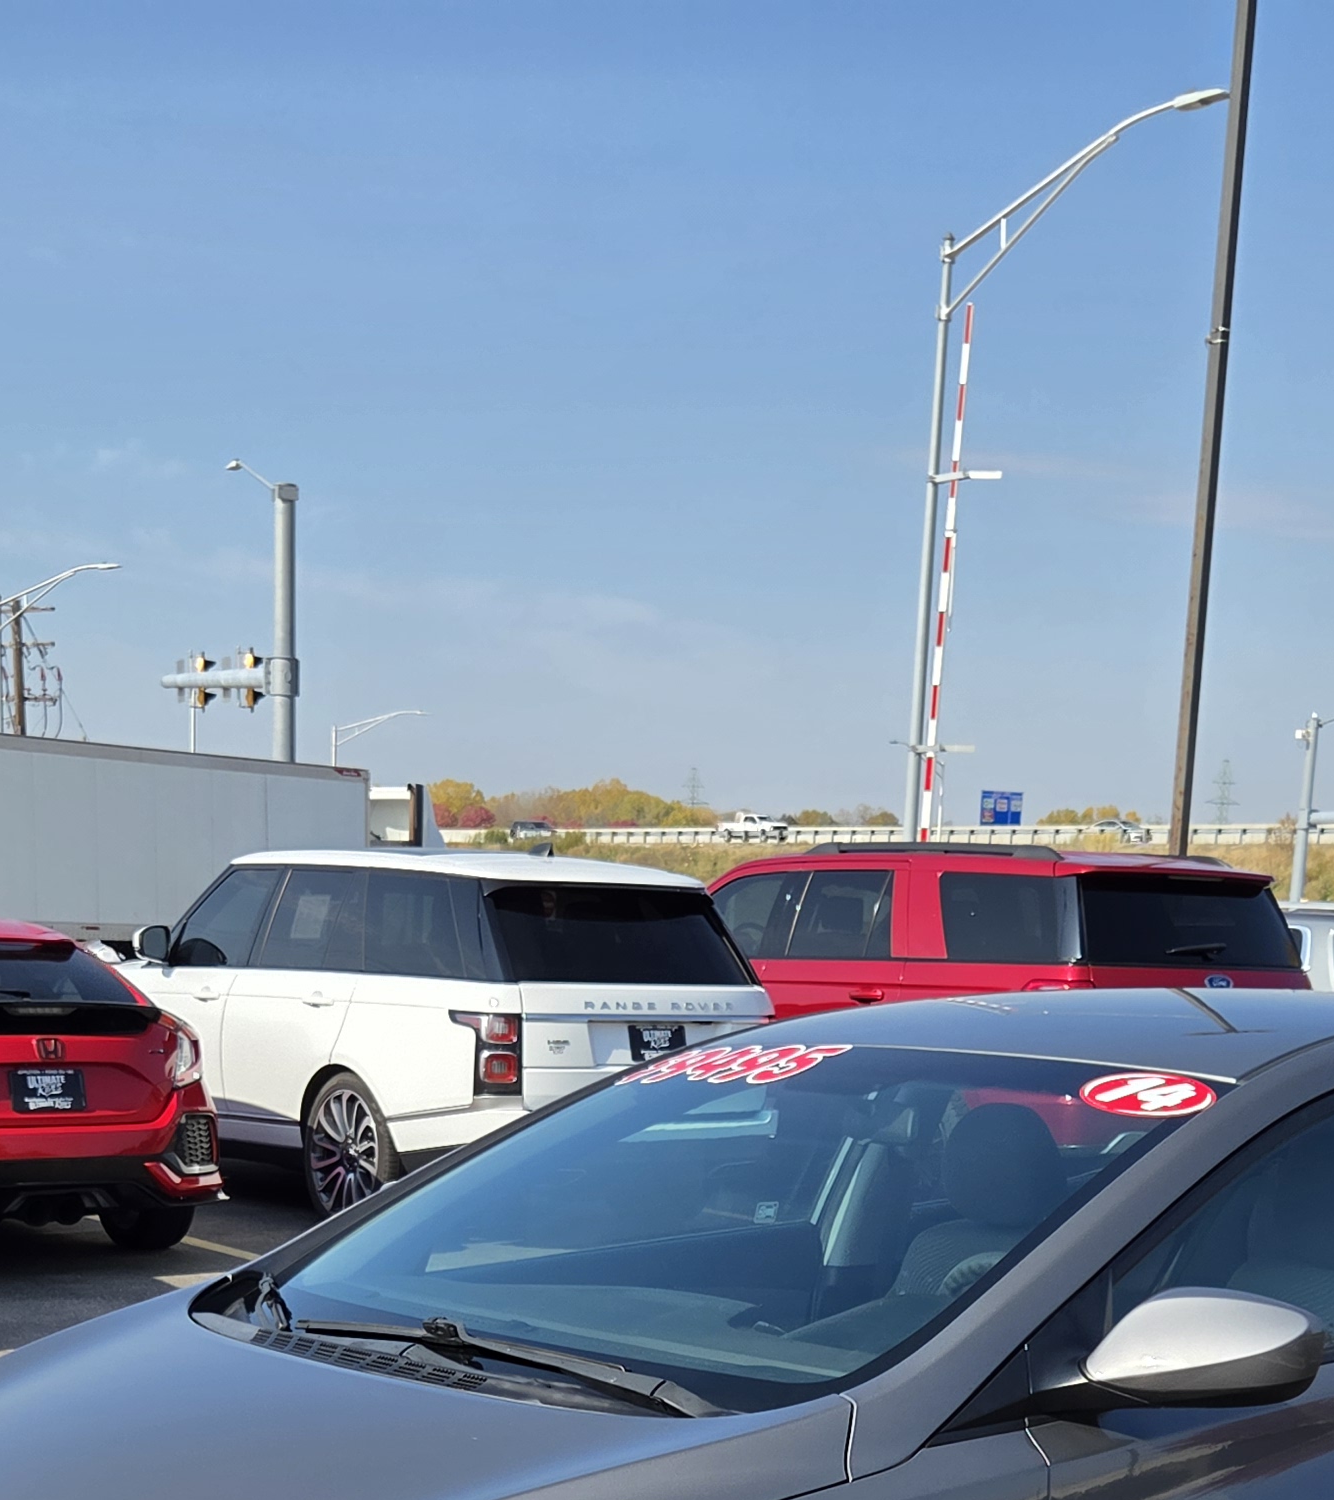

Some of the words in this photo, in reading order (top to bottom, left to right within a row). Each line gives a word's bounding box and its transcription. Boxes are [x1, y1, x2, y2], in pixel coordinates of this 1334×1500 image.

[584, 1001, 657, 1011] RANGE
[670, 1002, 733, 1012] ROVER
[27, 1075, 66, 1089] ULTIMATE
[1094, 1077, 1197, 1111] 14
